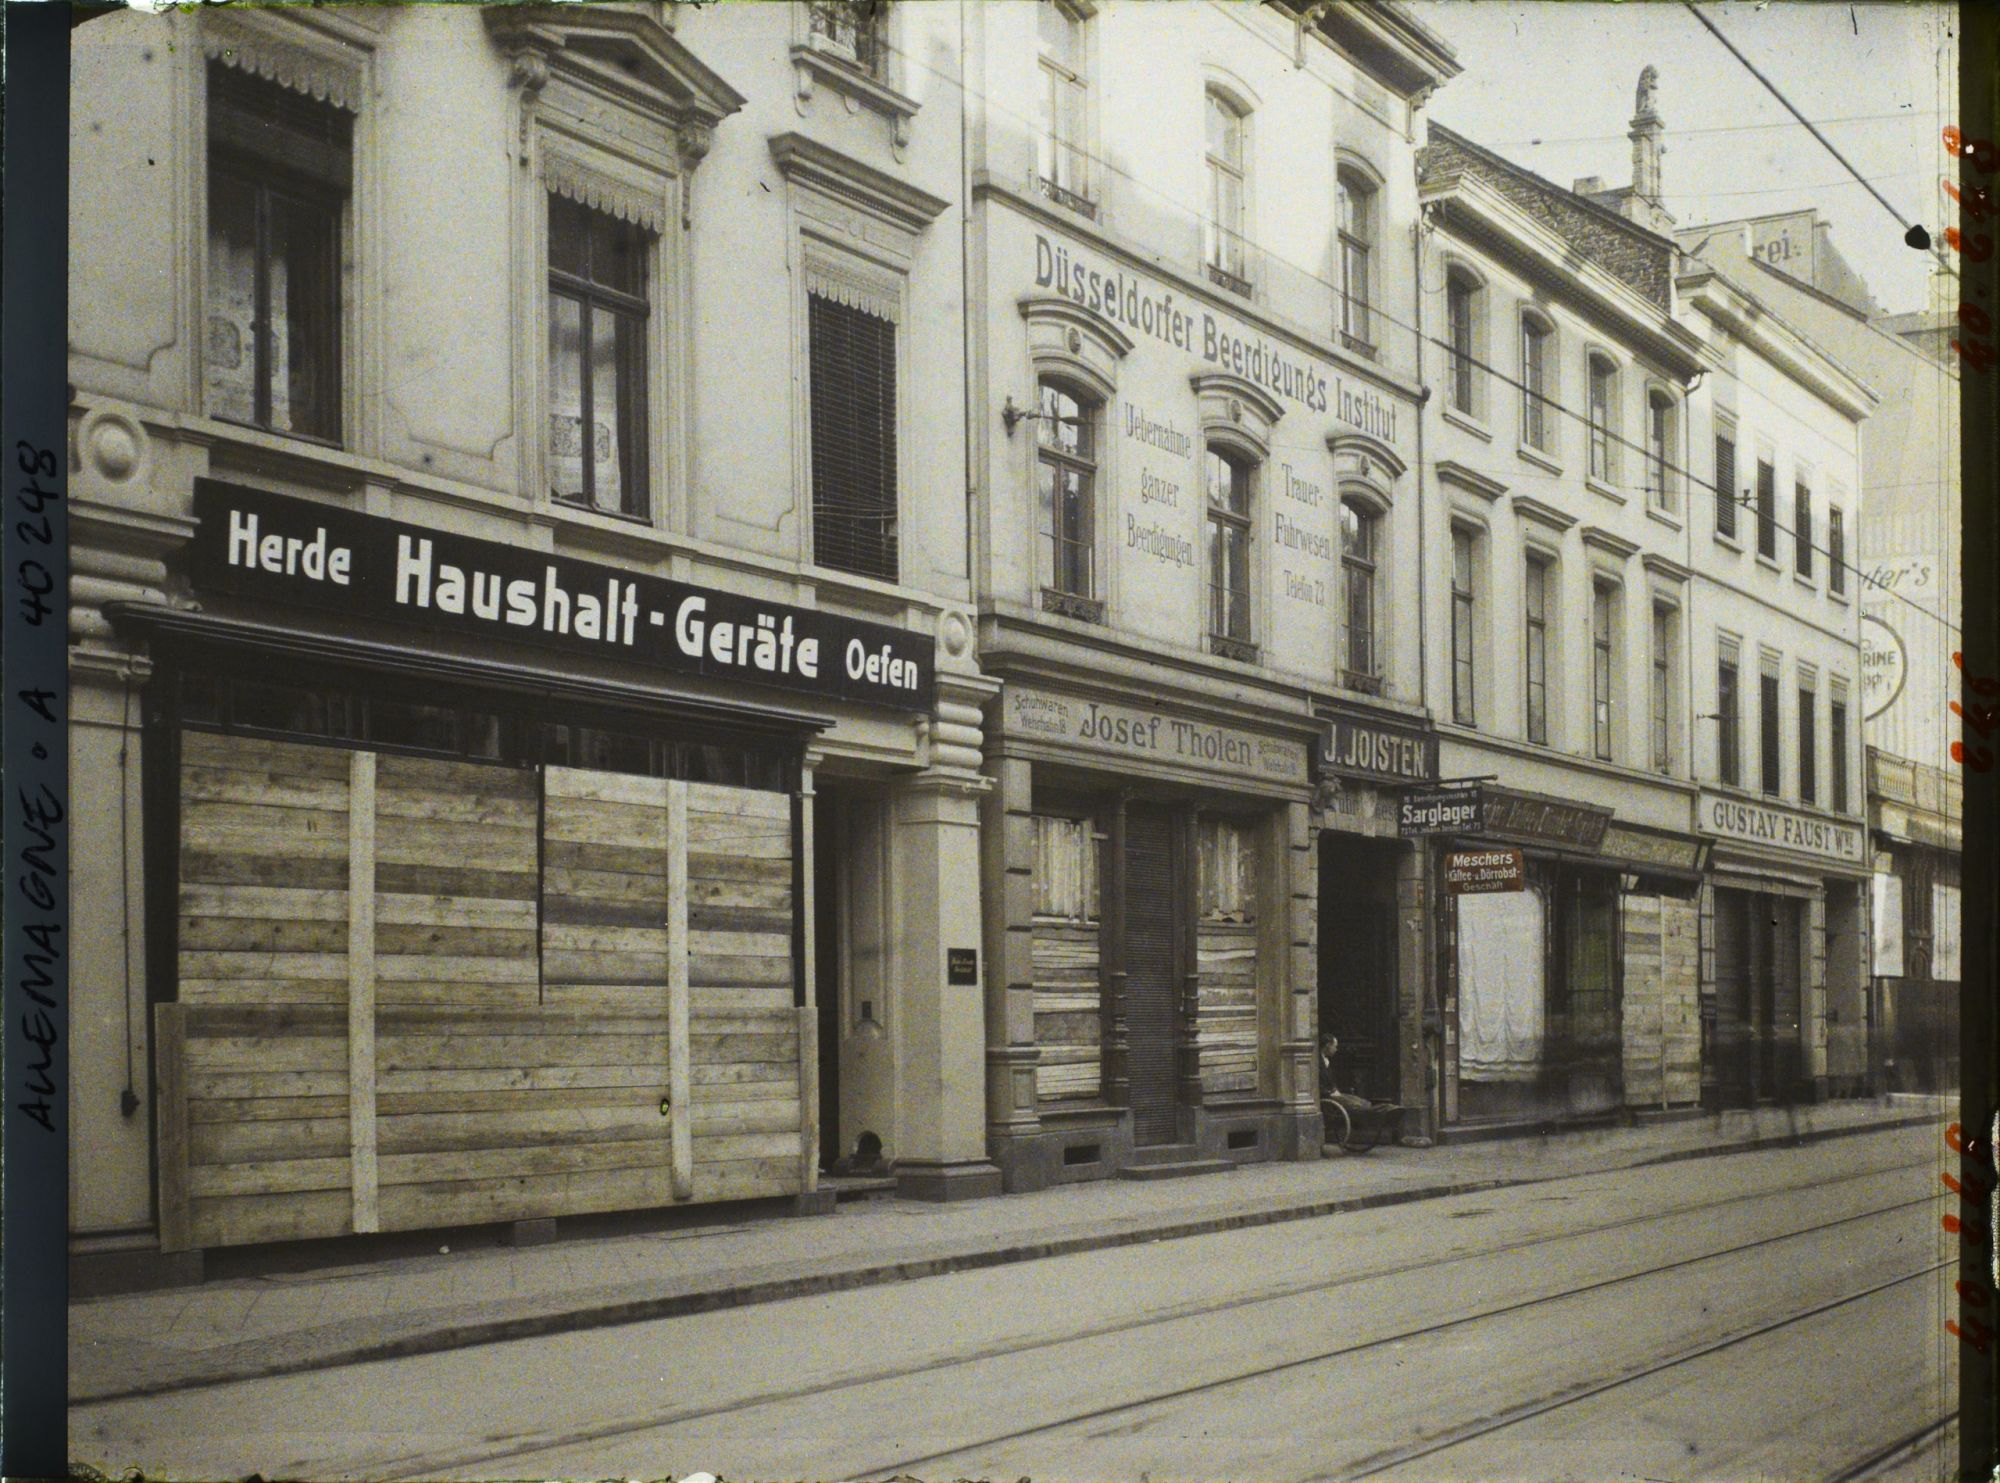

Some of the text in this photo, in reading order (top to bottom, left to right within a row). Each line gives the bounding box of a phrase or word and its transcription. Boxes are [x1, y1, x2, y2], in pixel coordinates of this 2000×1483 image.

[1035, 234, 1398, 444] Düsseldorfer Beerdigungs Institut
[1125, 402, 1192, 460] Uebernahme
[1141, 467, 1179, 508] ganzer
[1275, 511, 1330, 561] Fuhrwesen
[228, 510, 352, 585] Herde
[845, 638, 918, 691] Oefen
[1079, 703, 1161, 750] Josef
[1170, 720, 1252, 767] Tholen
[1324, 723, 1341, 764] J.
[1401, 802, 1477, 826] Sarglager
[1713, 801, 1778, 840] GUSTAV
[1784, 816, 1831, 851] FAUST
[1452, 852, 1514, 868] Meschers
[1462, 881, 1503, 892] Geschäft
